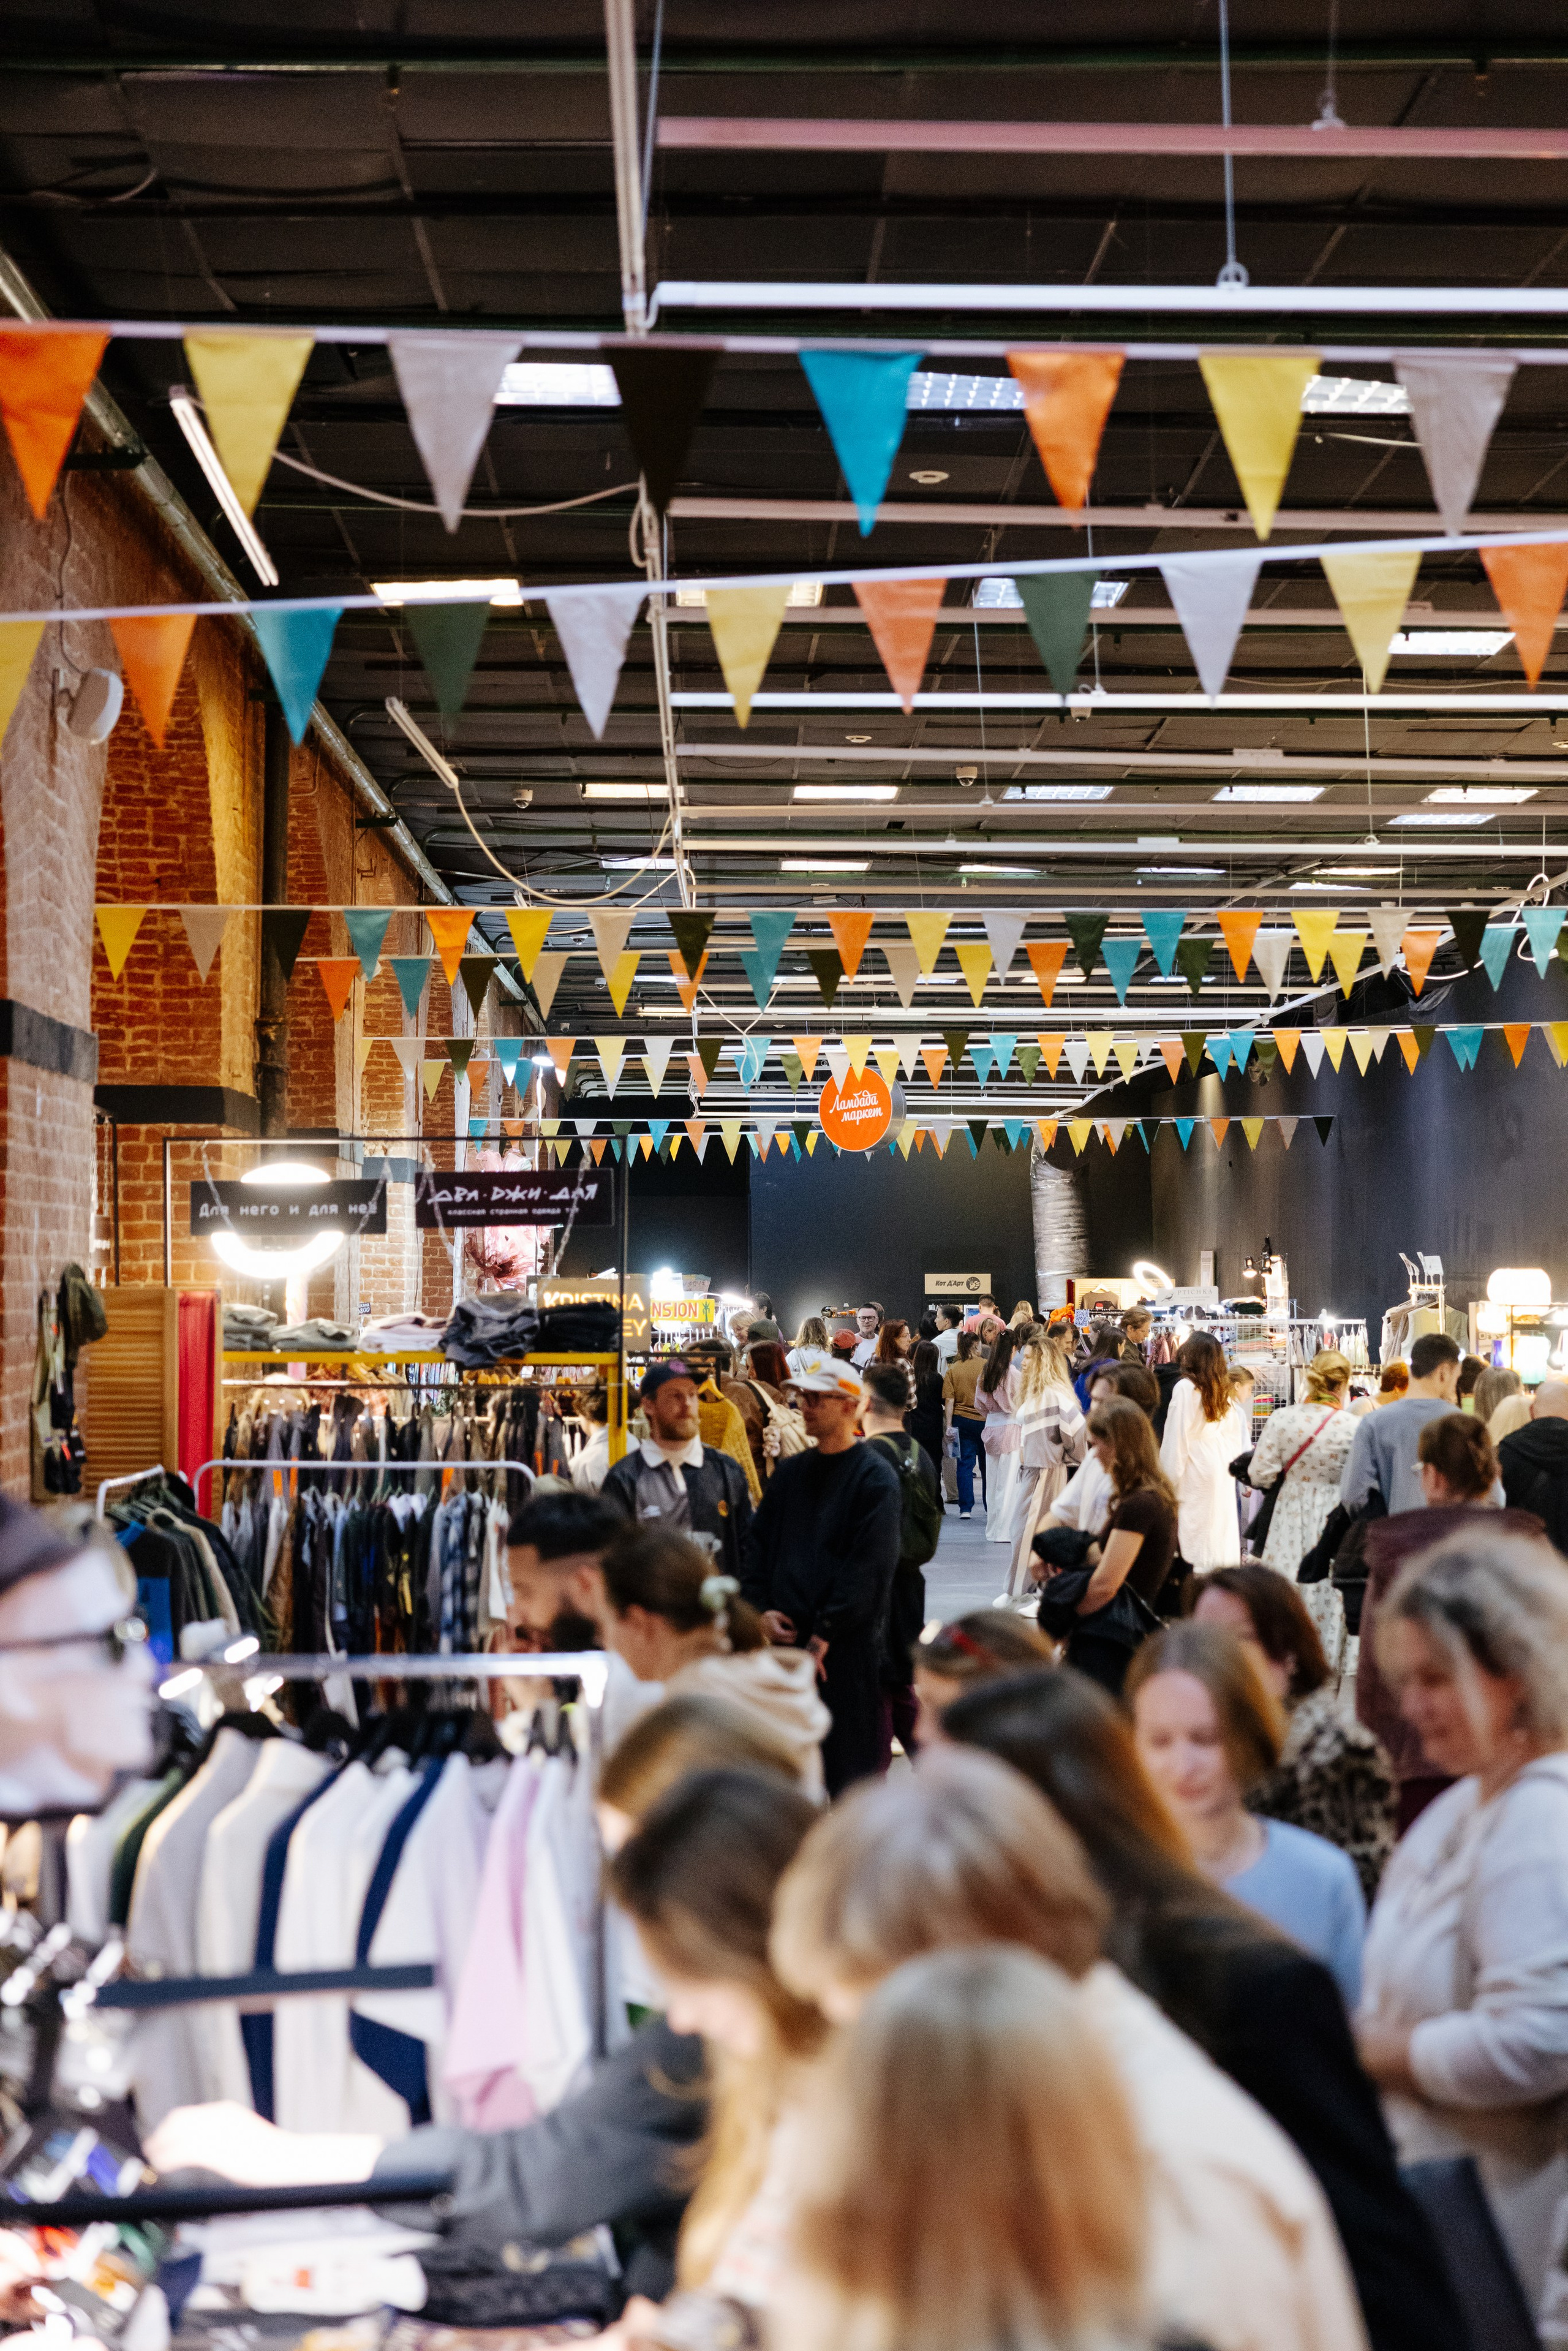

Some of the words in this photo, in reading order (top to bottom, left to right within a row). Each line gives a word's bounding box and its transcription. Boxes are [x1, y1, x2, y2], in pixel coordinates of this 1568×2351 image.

[829, 1090, 878, 1114] Ламбада
[841, 1107, 883, 1125] маркет
[199, 1202, 229, 1218] Для
[239, 1204, 279, 1216] него
[289, 1204, 300, 1215] и
[309, 1204, 338, 1217] для
